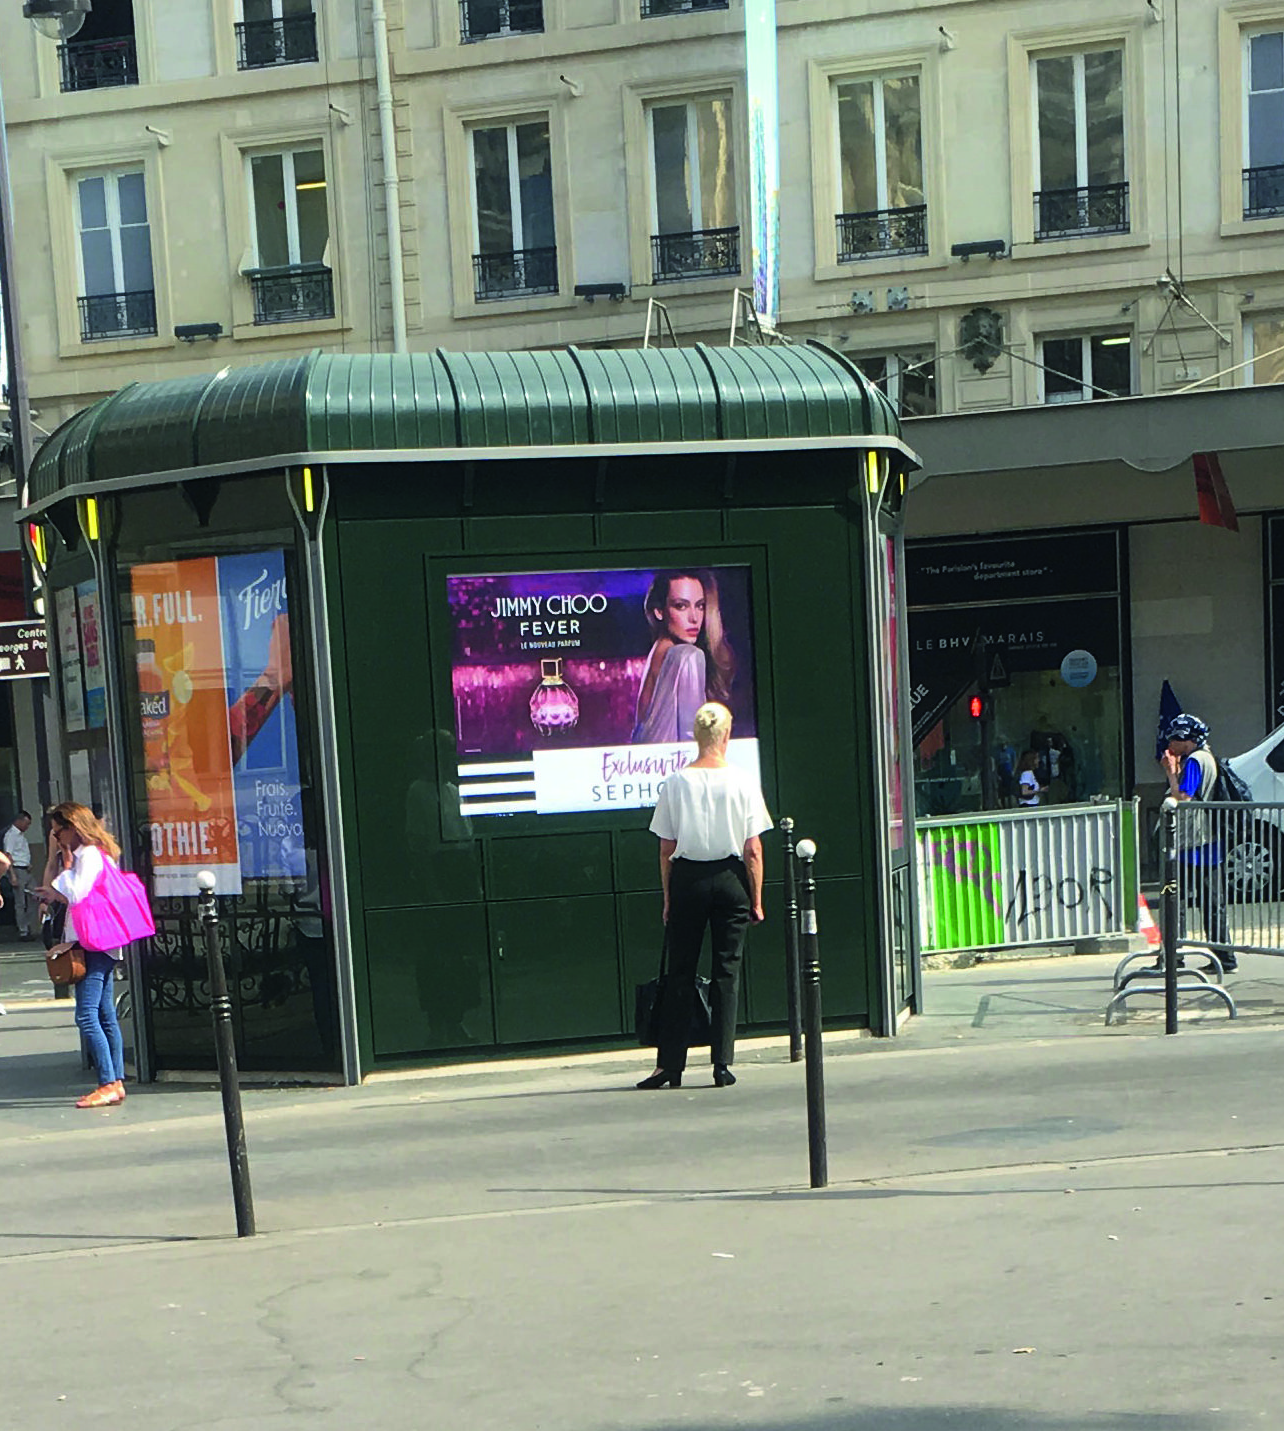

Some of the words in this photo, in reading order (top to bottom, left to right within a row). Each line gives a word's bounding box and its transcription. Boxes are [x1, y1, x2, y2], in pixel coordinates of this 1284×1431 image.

[490, 596, 542, 617] JIMMY
[546, 593, 608, 615] CHOO
[520, 619, 580, 636] FEVER
[520, 641, 528, 649] LE
[529, 640, 556, 649] NOUVEAU
[557, 639, 581, 648] PARFUM
[916, 639, 933, 651] LE
[255, 780, 289, 797] Frais.
[256, 800, 297, 817] Fruité.
